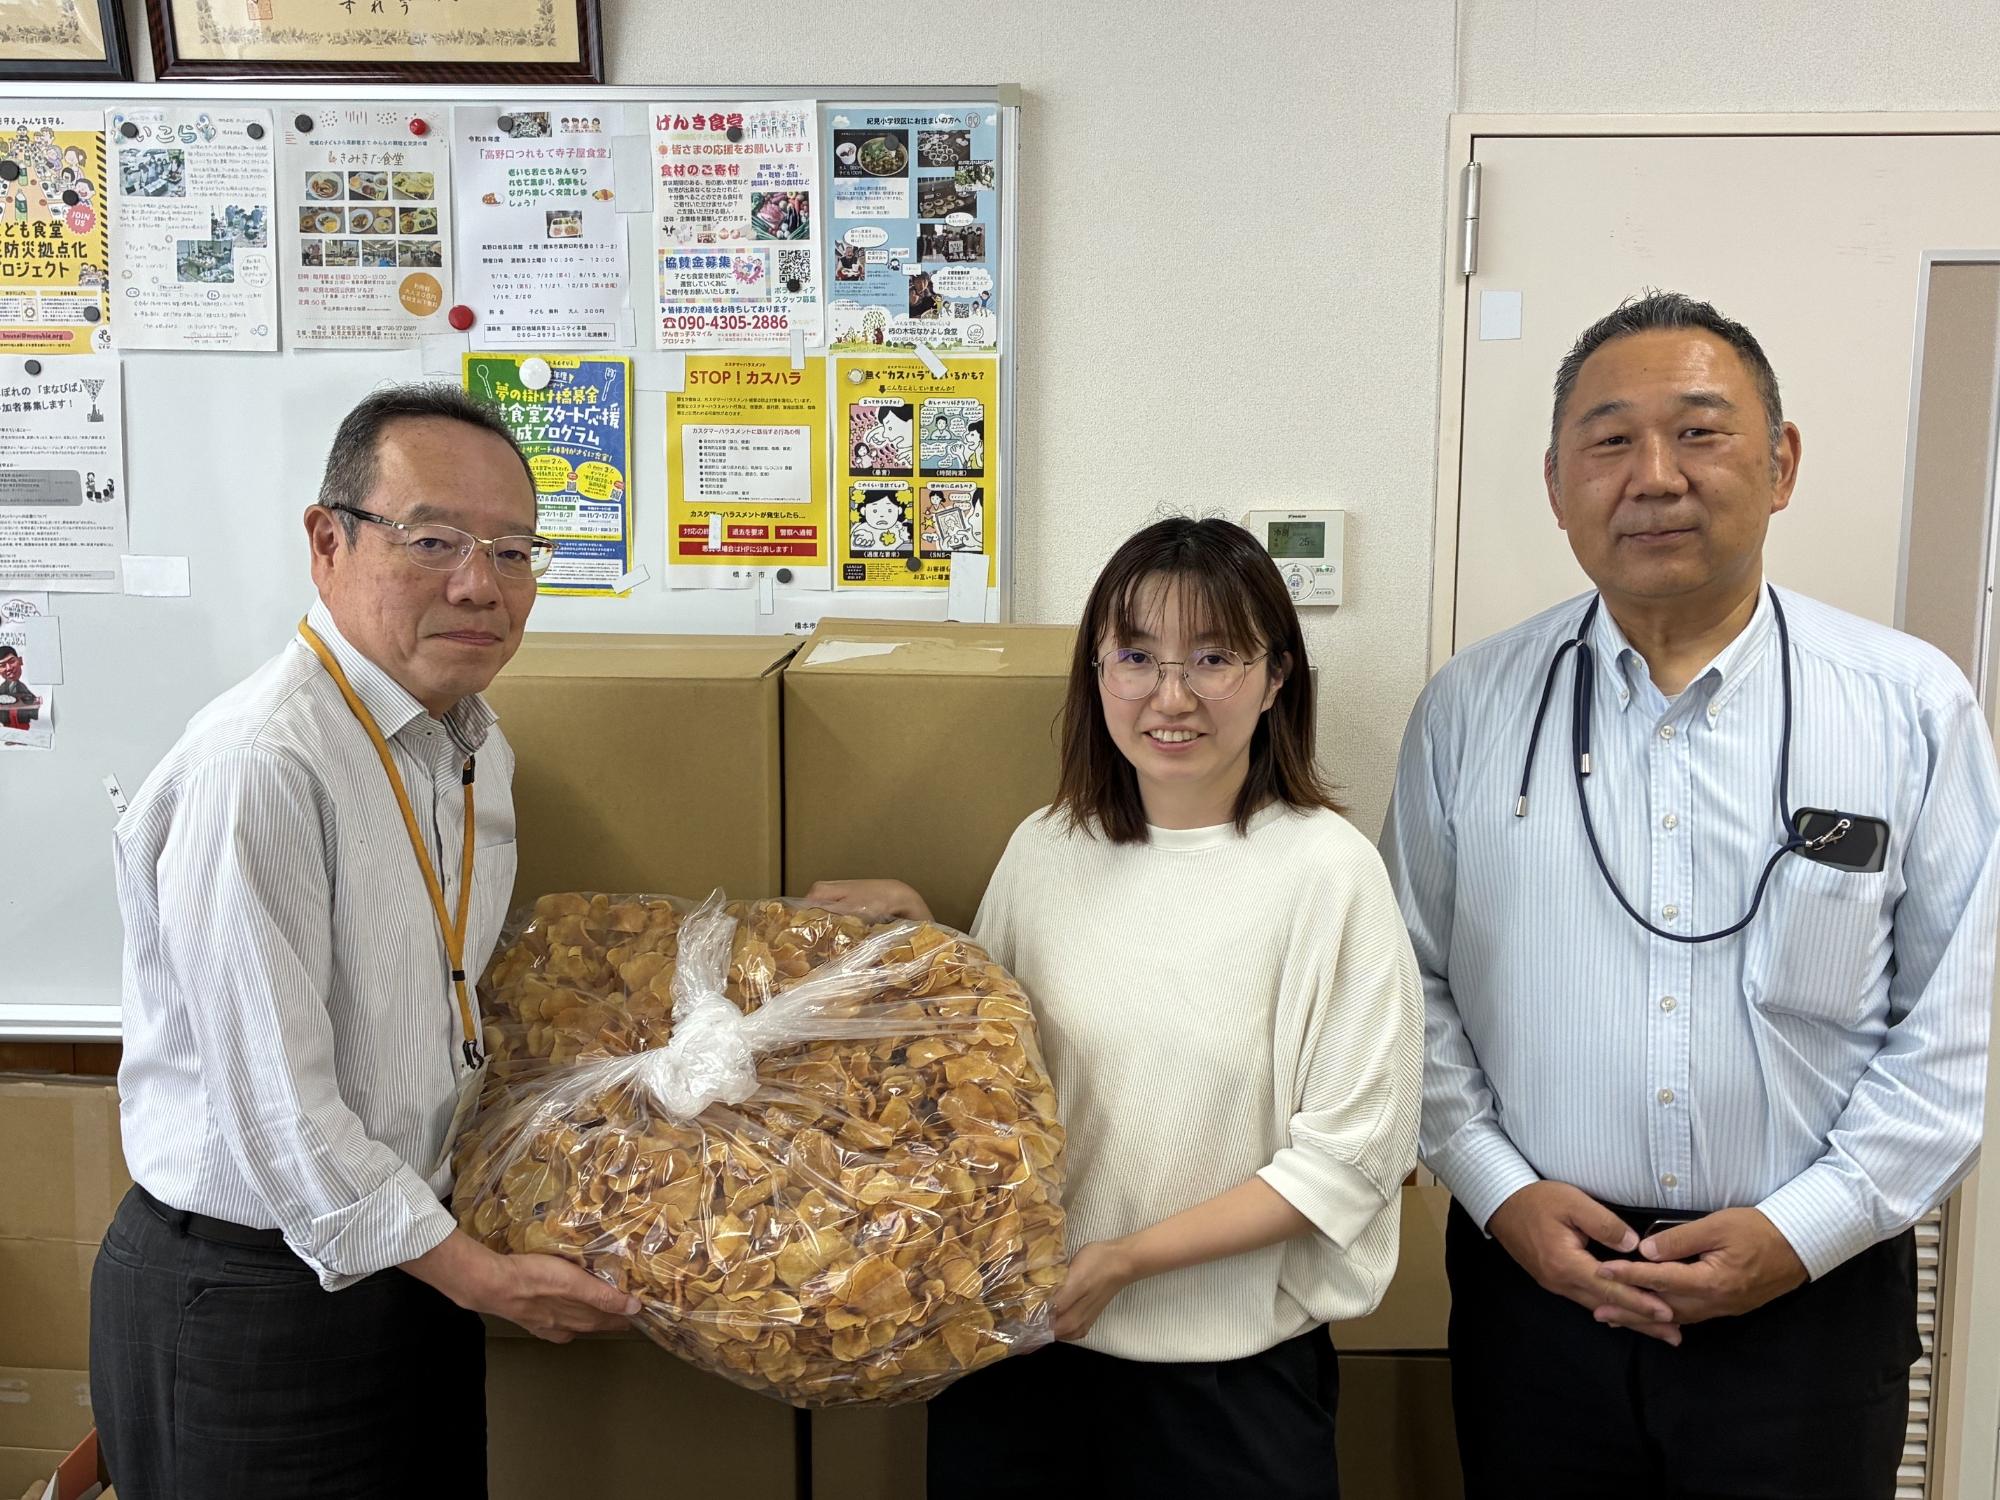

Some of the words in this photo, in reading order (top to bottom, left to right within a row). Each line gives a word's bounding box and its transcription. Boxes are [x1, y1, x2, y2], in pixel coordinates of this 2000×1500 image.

[656, 113, 744, 131] げんき食堂
[660, 163, 740, 177] 食材のご寄付
[0, 220, 64, 238] ども食堂
[75, 219, 86, 227] US
[0, 240, 88, 258] 防災拠点化
[0, 261, 69, 278] ロジェクト
[665, 256, 731, 269] 協賛金募集
[775, 286, 815, 294] ボラィア
[678, 315, 788, 330] 090-4305-2886
[0, 400, 73, 412] 加者募集します！
[511, 424, 600, 445] 成プログラム
